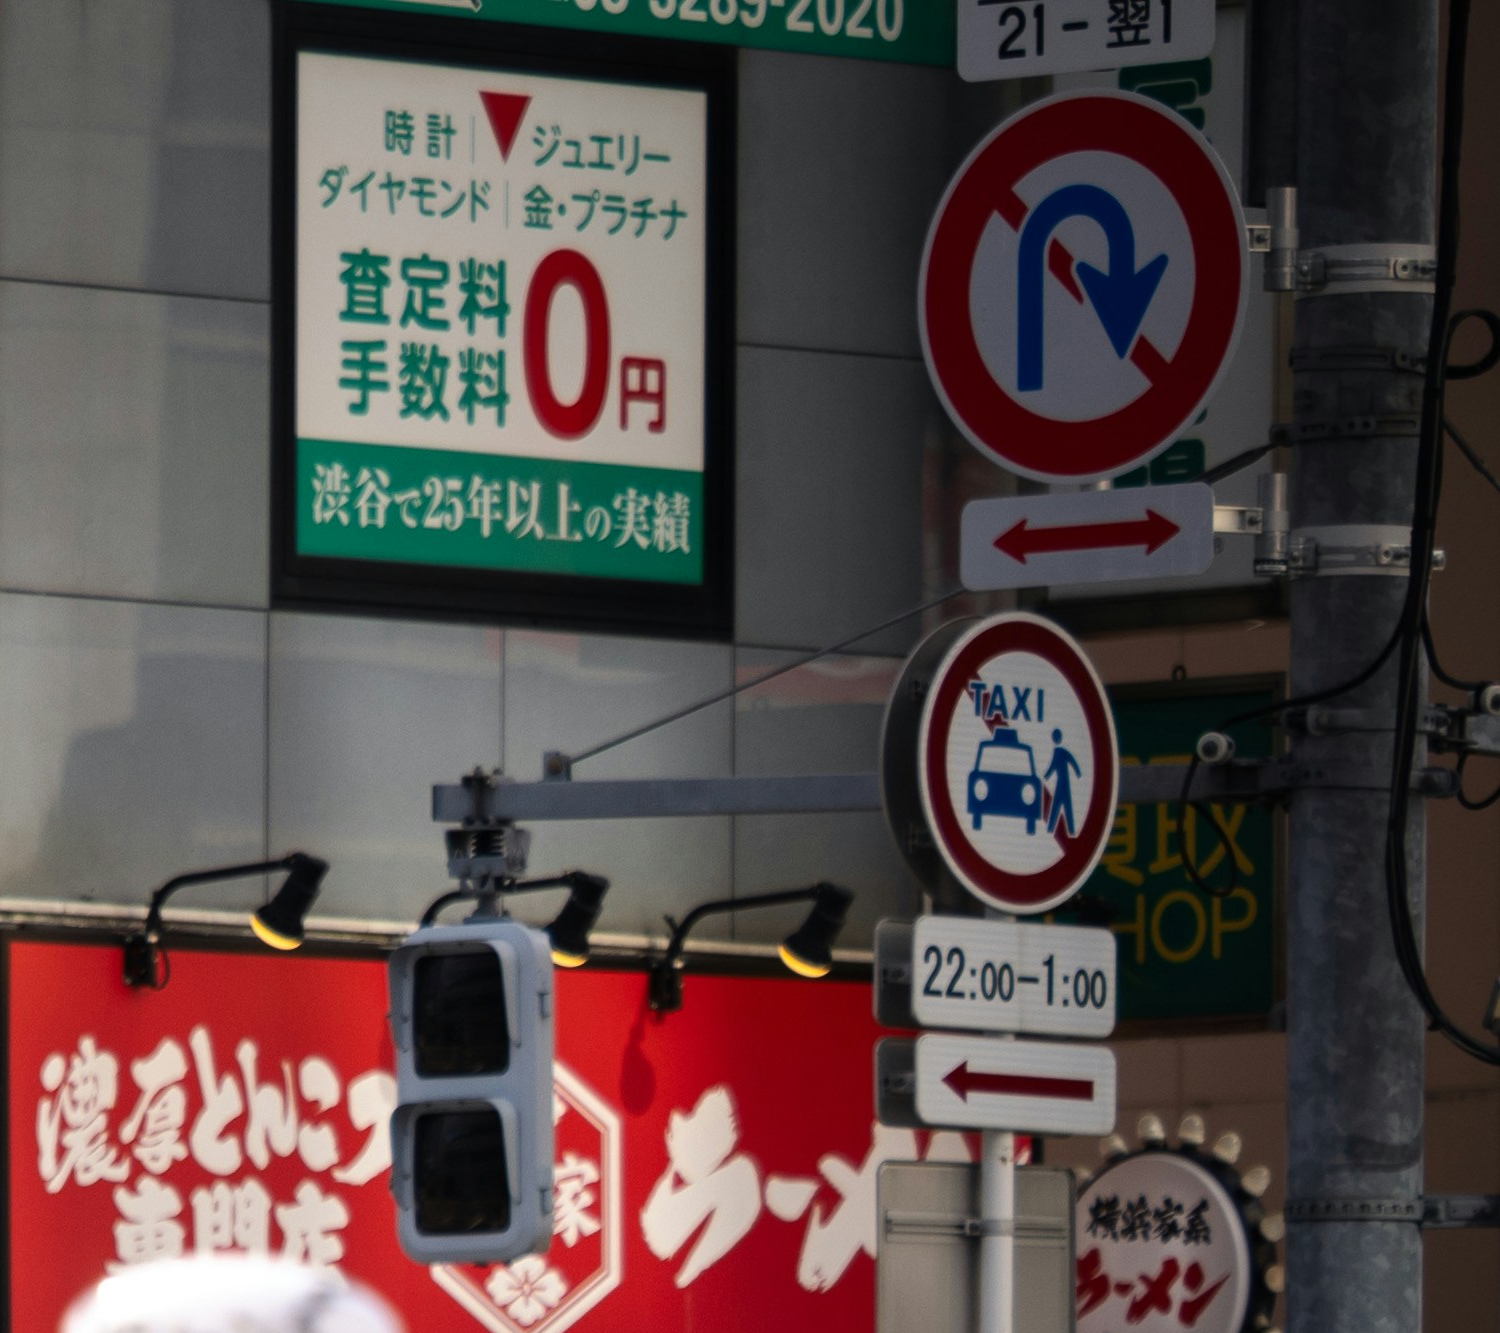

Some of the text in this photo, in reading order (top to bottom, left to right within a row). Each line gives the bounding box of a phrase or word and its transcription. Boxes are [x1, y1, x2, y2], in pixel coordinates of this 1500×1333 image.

[383, 110, 457, 160] 時計
[531, 124, 672, 177] ジュエリー
[319, 166, 491, 223] ダイヤモンド
[523, 184, 689, 241] 金・プラチナ
[338, 248, 511, 338] 査定料
[338, 338, 511, 428] 手数料
[310, 461, 692, 556] 渋谷で25年以上の実績
[970, 682, 1045, 722] TAXI
[1111, 887, 1259, 966] HOP
[922, 945, 1107, 1010] 22:00-1:00
[36, 1024, 397, 1195] 濃厚とんこつ
[640, 1084, 971, 1295] ラーメ
[1086, 1196, 1213, 1246] 横浜家系
[1076, 1248, 1232, 1329] ラーメン
